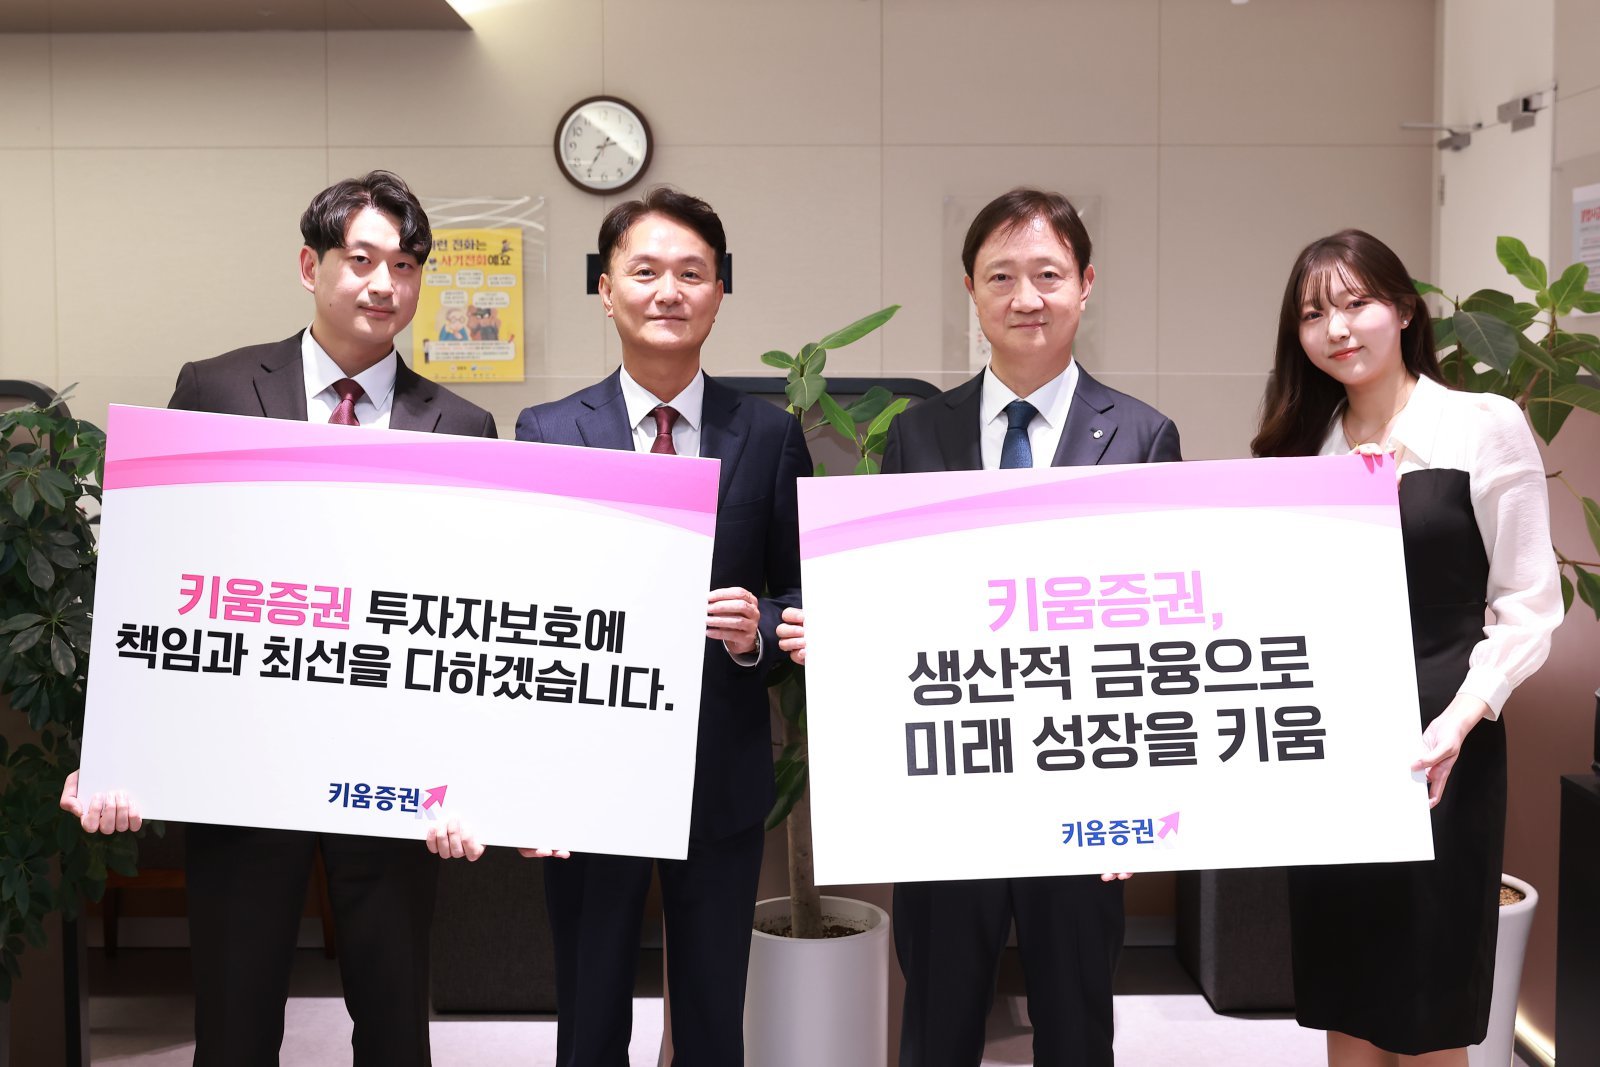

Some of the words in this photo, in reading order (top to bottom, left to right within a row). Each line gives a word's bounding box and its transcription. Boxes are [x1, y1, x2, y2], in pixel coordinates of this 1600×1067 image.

[569, 142, 577, 152] 9
[573, 127, 582, 137] 10
[601, 172, 608, 182] 6
[617, 168, 624, 178] 5
[178, 574, 351, 631] 키움증권
[366, 590, 626, 654] 투자자보호에
[988, 570, 1223, 633] 키움증권,
[115, 622, 248, 677] 책임과
[260, 635, 392, 689] 최선을
[404, 648, 674, 712] 다하겠습니다.
[907, 645, 1073, 707] 생산적
[1091, 636, 1314, 699] 금융으로
[905, 717, 1014, 777] 미래
[1032, 711, 1198, 772] 성장을
[1217, 705, 1327, 764] 키움
[328, 782, 420, 813] 키움증권
[1061, 818, 1154, 847] 키움증권
